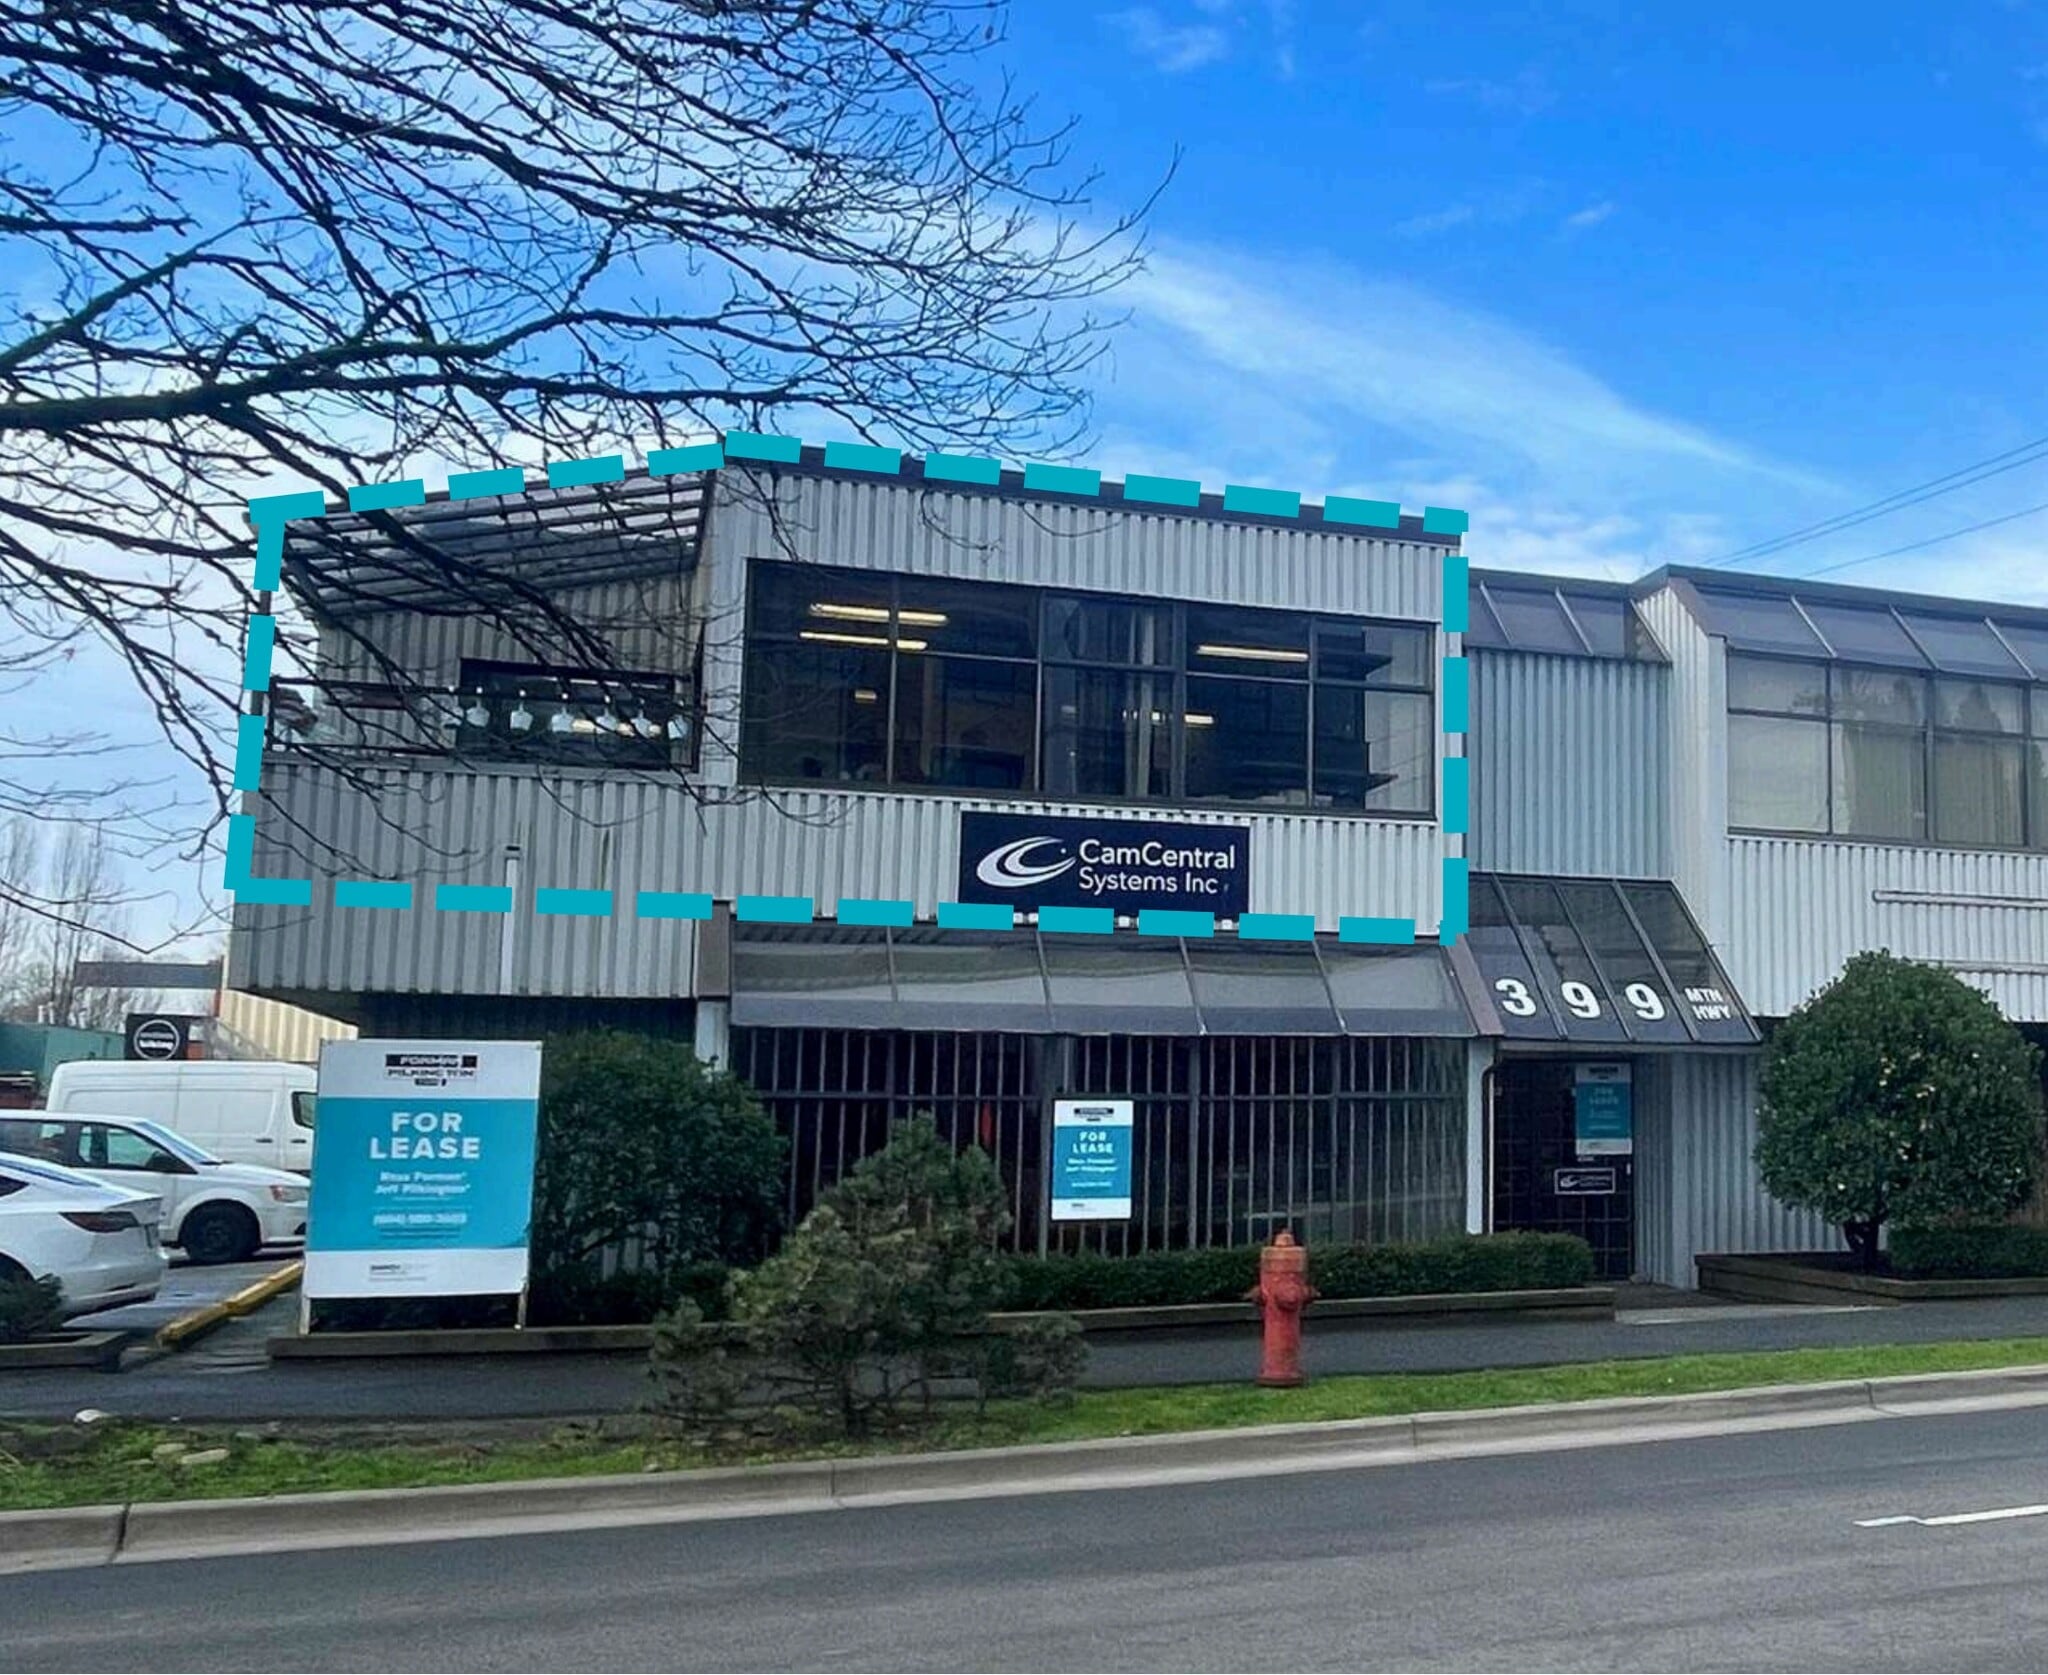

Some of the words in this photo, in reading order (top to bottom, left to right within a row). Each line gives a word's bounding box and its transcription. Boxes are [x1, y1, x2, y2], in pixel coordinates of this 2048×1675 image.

[1078, 838, 1235, 869] CamCentral
[1078, 867, 1178, 895] Systems
[1684, 987, 1724, 1002] MTN
[1692, 1004, 1731, 1020] HWY
[391, 1111, 463, 1133] FOR
[370, 1137, 480, 1159] LEASE
[1073, 1143, 1114, 1154] LEASE
